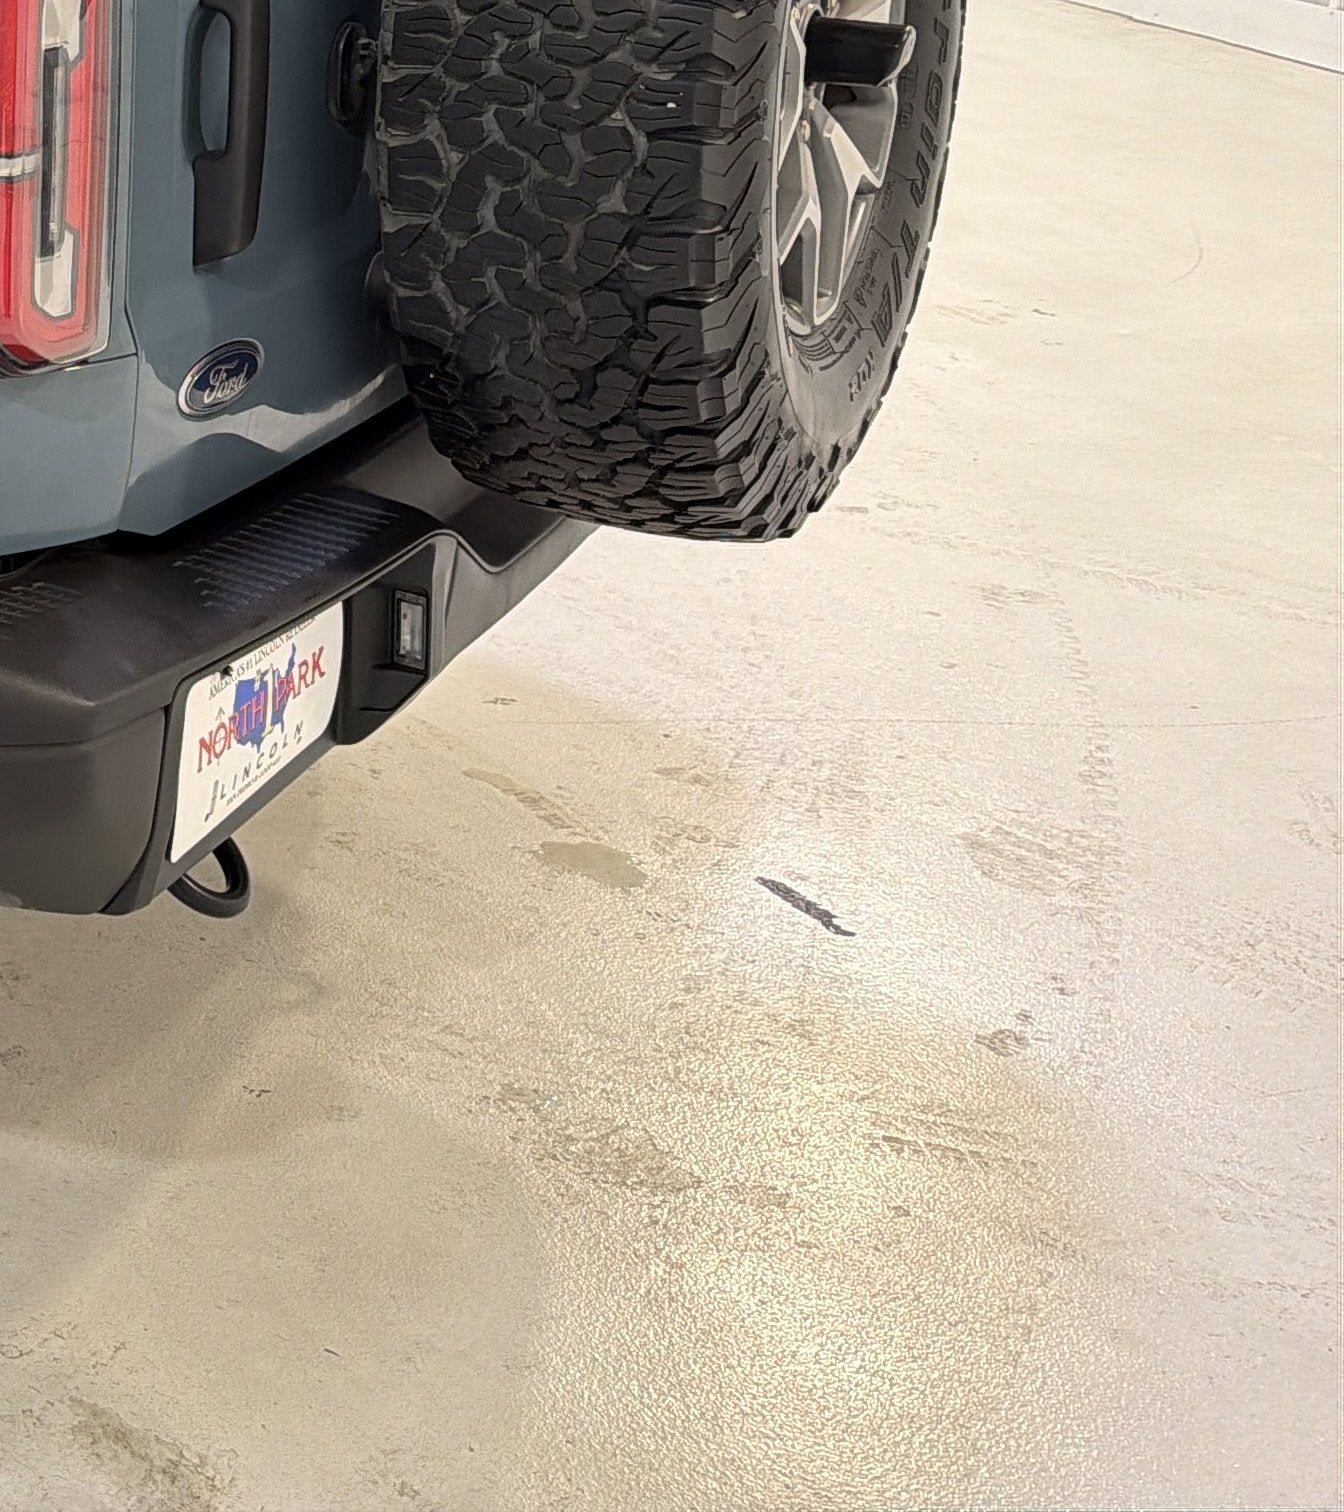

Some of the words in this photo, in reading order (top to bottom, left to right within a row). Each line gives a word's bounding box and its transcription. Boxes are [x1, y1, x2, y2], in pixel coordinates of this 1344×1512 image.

[203, 359, 249, 404] Ford
[196, 689, 266, 774] NORTH
[275, 646, 327, 713] PARK
[220, 719, 304, 801] LINCOLN
